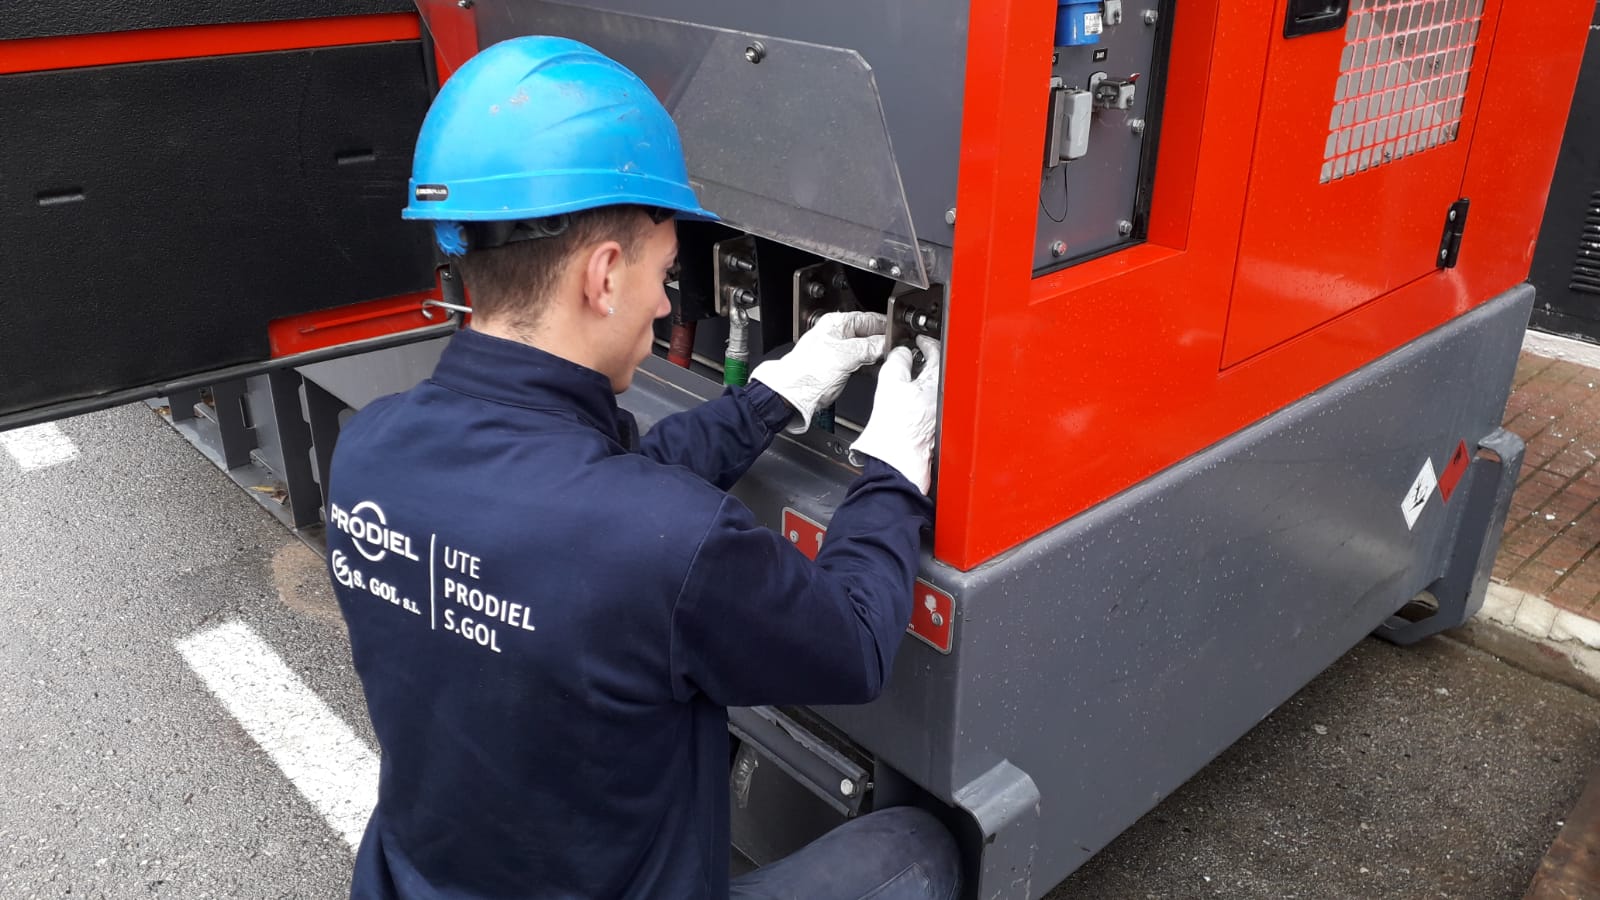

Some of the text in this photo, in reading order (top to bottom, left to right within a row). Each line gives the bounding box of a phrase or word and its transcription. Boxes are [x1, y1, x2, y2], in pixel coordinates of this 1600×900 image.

[331, 503, 420, 562] PRODIEL
[444, 546, 481, 580] UTE
[353, 569, 367, 590] S.
[369, 577, 401, 606] GOL
[444, 577, 536, 631] PRODIEL
[444, 609, 502, 654] S.GOL
